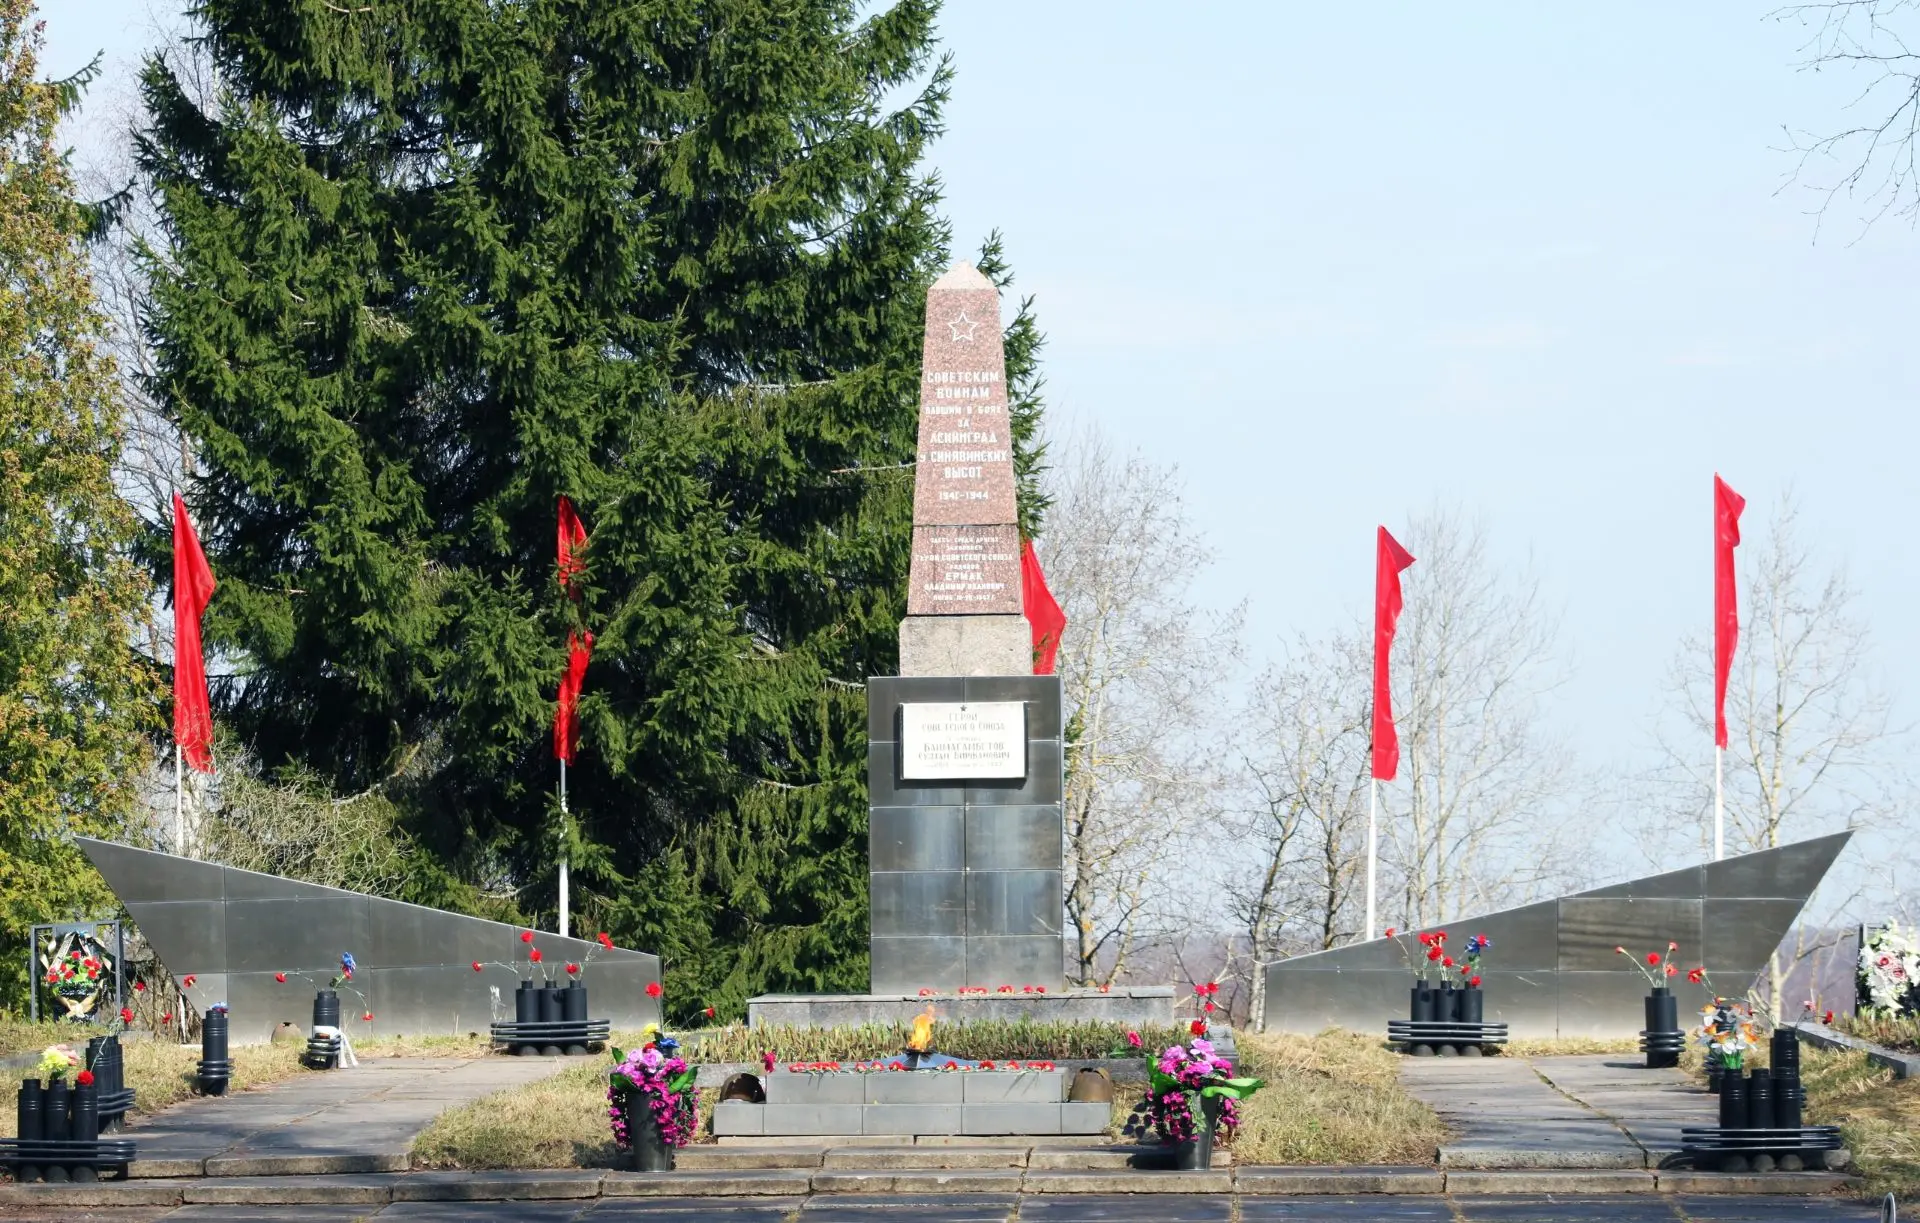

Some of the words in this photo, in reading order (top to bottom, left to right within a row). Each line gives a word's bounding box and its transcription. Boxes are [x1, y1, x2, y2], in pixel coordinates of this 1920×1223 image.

[927, 371, 999, 383] СОВЕТСКИМ
[930, 431, 998, 444] ЛЕНИНГРАД
[930, 450, 1008, 463] СИНЯВИНСКИХ
[944, 466, 983, 479] ВЫСОТ
[945, 572, 984, 581] ЕРМАК
